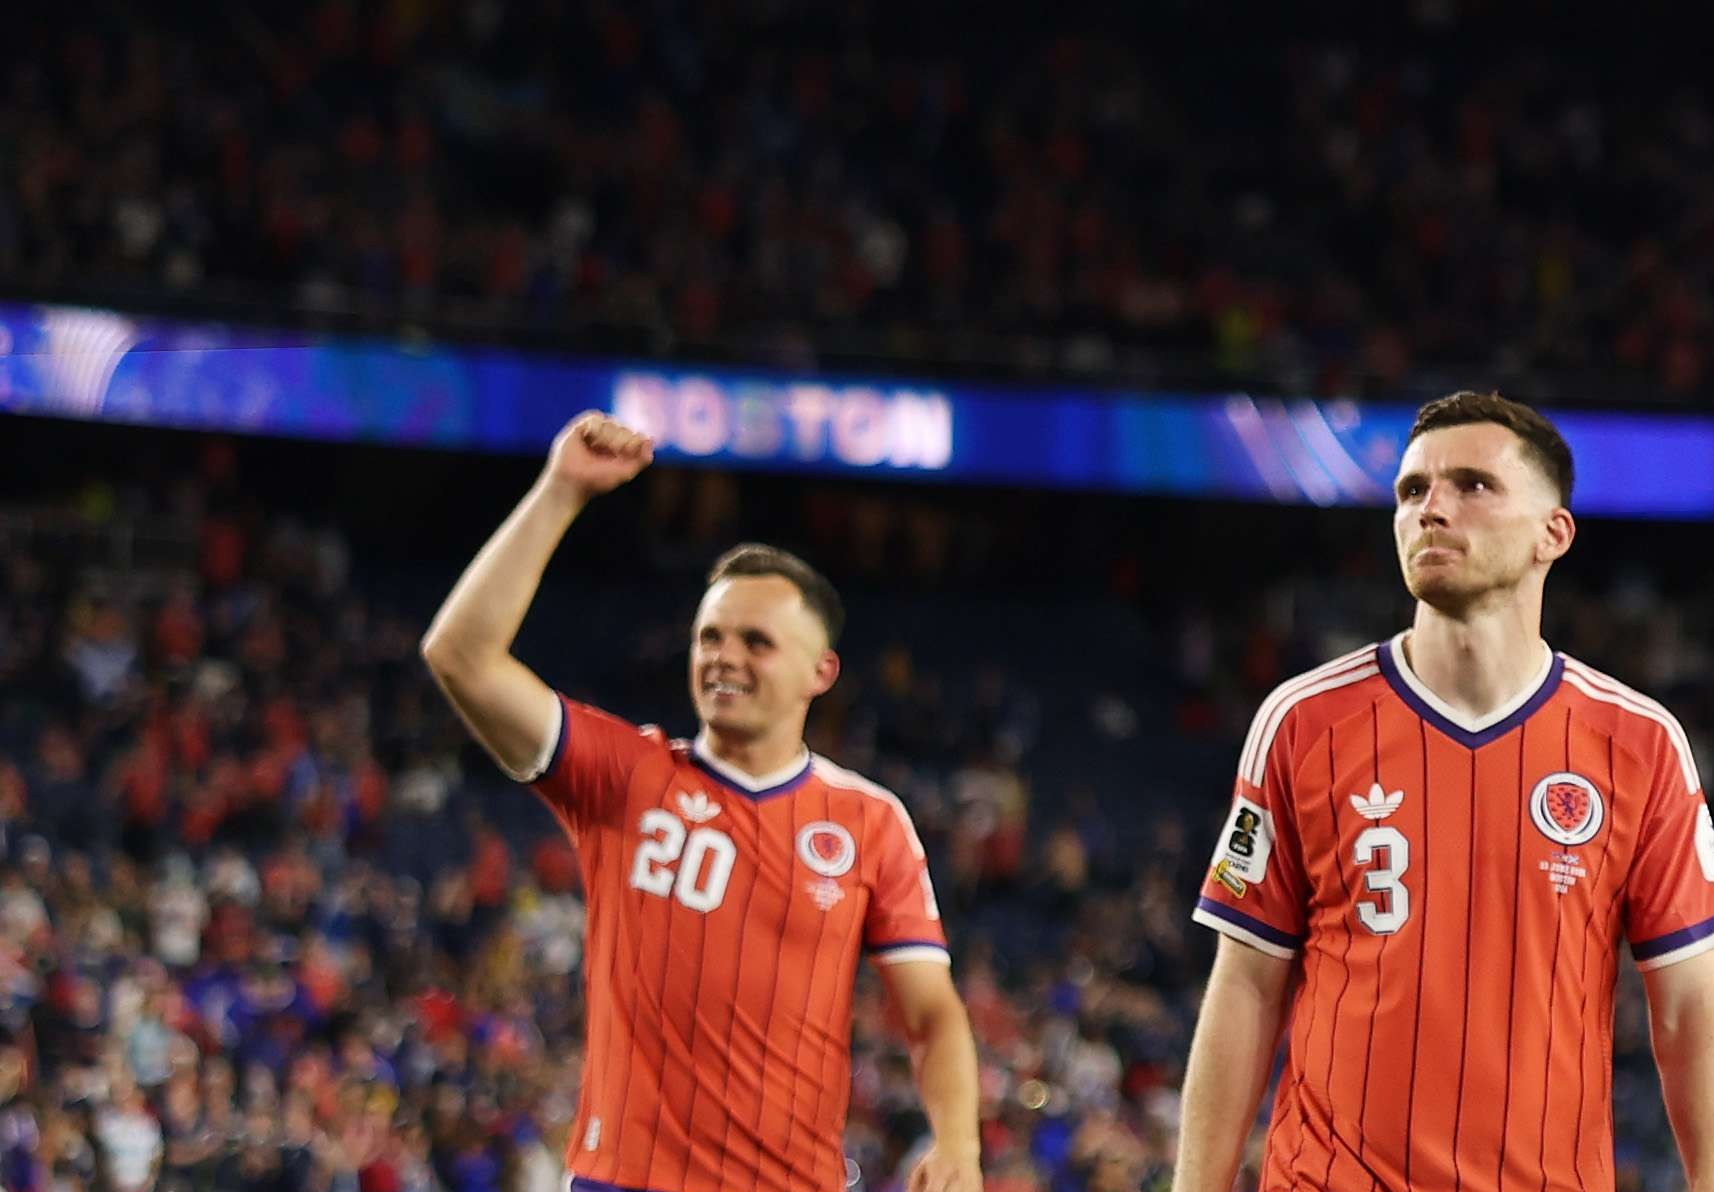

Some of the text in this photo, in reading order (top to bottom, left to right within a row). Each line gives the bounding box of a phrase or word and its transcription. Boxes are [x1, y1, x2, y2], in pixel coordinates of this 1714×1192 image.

[614, 370, 952, 470] BOSTON
[630, 808, 737, 914] 20
[1352, 825, 1410, 937] 3
